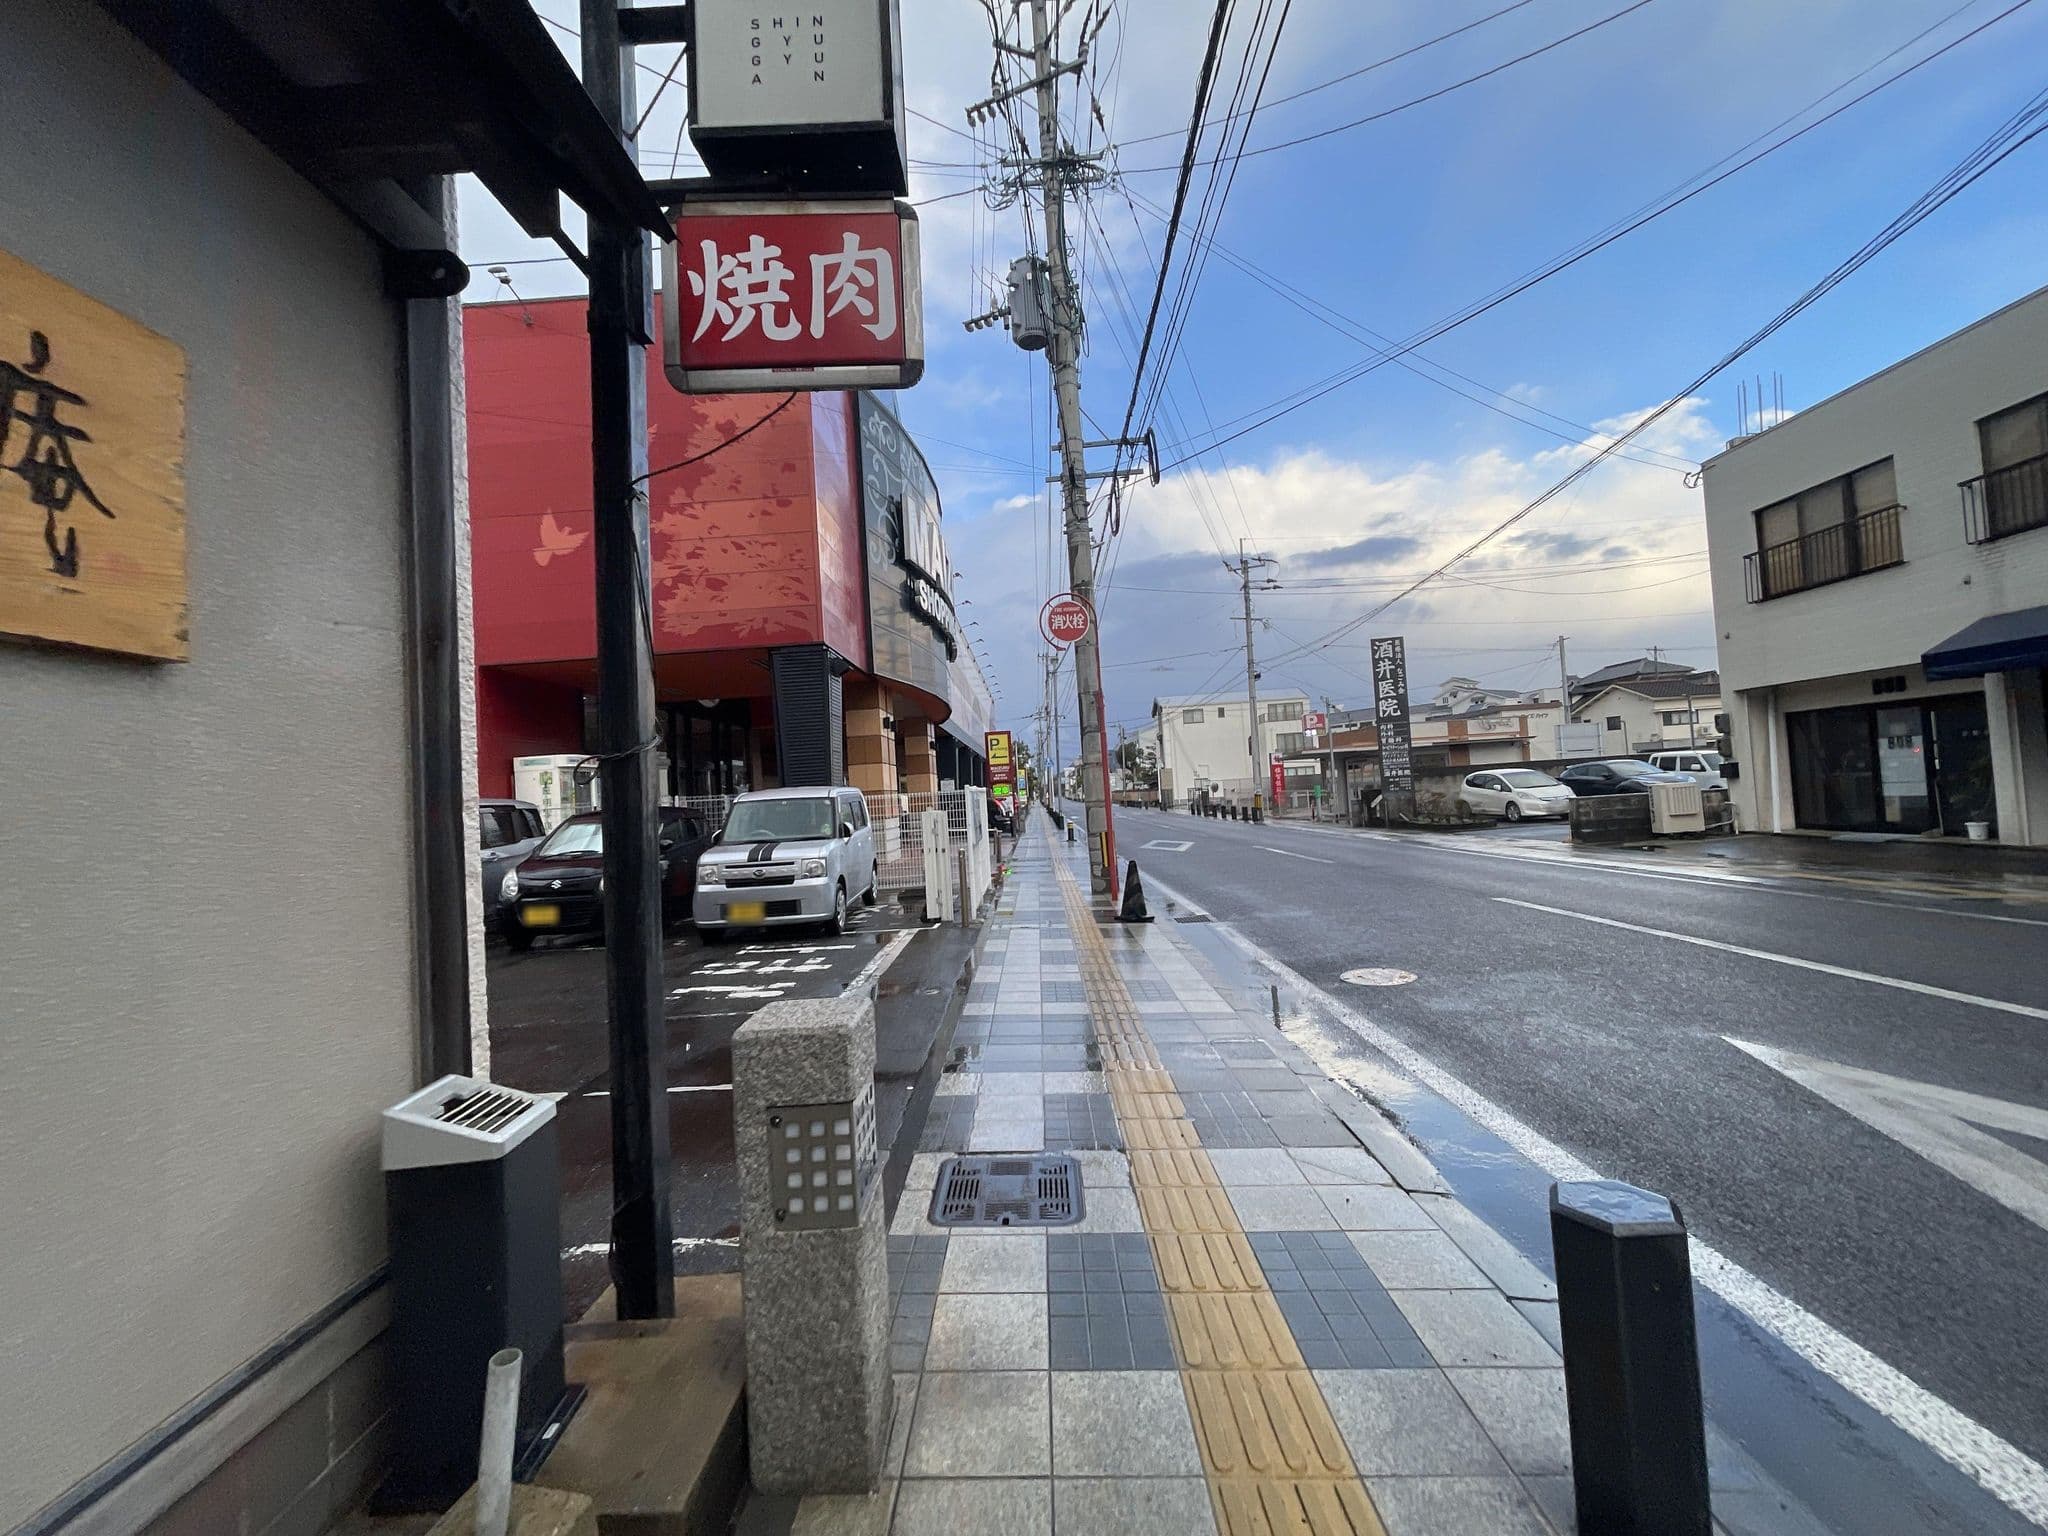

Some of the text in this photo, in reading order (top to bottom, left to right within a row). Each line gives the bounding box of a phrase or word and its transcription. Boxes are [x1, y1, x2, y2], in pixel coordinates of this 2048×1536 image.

[750, 15, 823, 31] SHIN
[687, 231, 898, 344] 焼肉
[1051, 613, 1085, 630] 消火栓
[1374, 640, 1402, 718] 酒井医院
[1305, 714, 1318, 729] P
